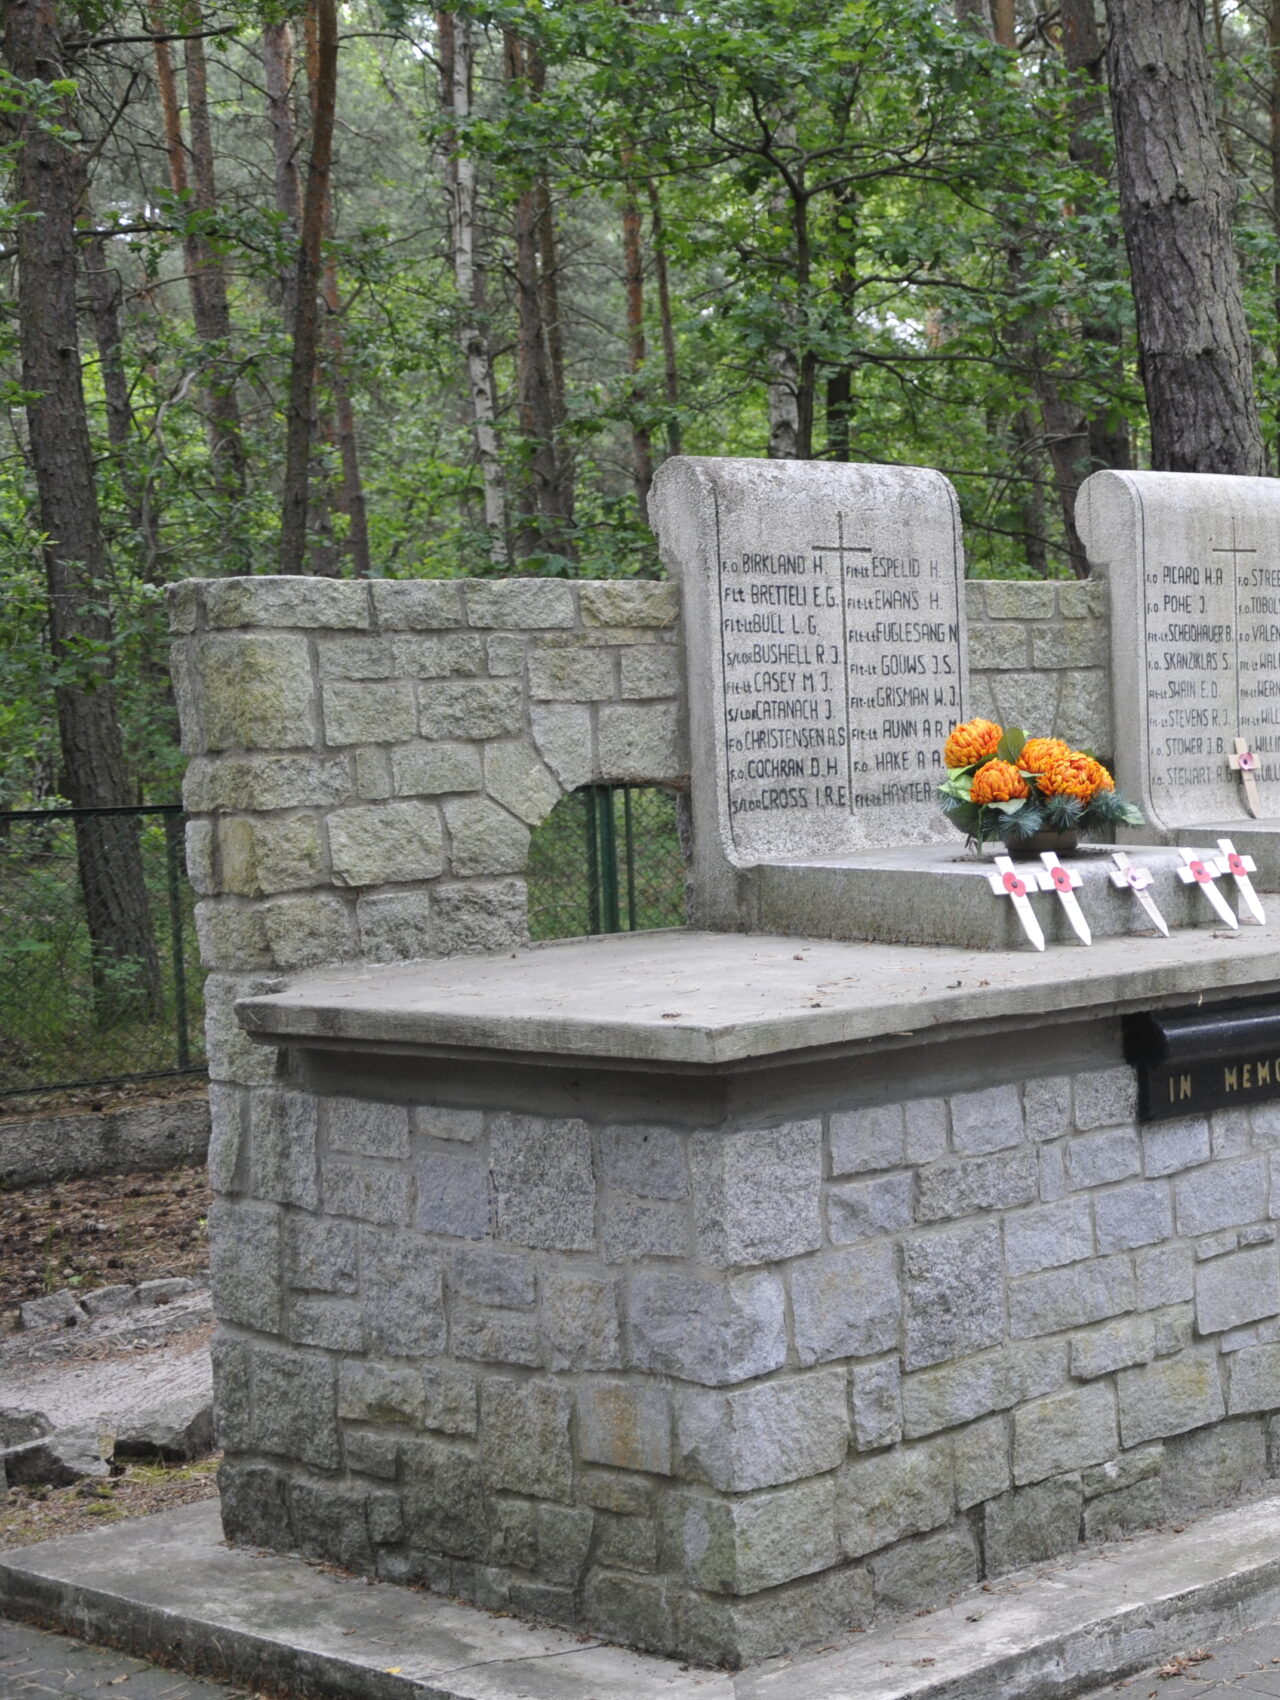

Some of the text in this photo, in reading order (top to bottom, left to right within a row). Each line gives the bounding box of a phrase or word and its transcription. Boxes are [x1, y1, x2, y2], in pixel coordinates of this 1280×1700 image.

[743, 553, 805, 574] BIRKLAND
[872, 557, 920, 578] ESPELID
[1163, 566, 1200, 585] PICARD
[875, 590, 919, 610] EWANS
[1164, 595, 1192, 614] POHE
[753, 613, 785, 633] BULL
[876, 622, 946, 642] FUGLESANG
[753, 644, 812, 664] BUSHELL
[881, 655, 926, 676] GOUWS
[754, 671, 796, 693] CASEY
[1168, 680, 1196, 699] SWAIN
[876, 687, 929, 707] GRISMAN
[756, 699, 818, 720] CATANACH
[1168, 709, 1208, 728] STEVENS
[745, 728, 825, 751] CHRISTENSEN
[1165, 737, 1202, 756] STOWER
[748, 758, 804, 779] COCHRAN
[876, 751, 909, 771] HAKE
[1167, 766, 1211, 786] STEWART
[762, 788, 808, 810] CROSS
[1169, 1074, 1192, 1103] IN
